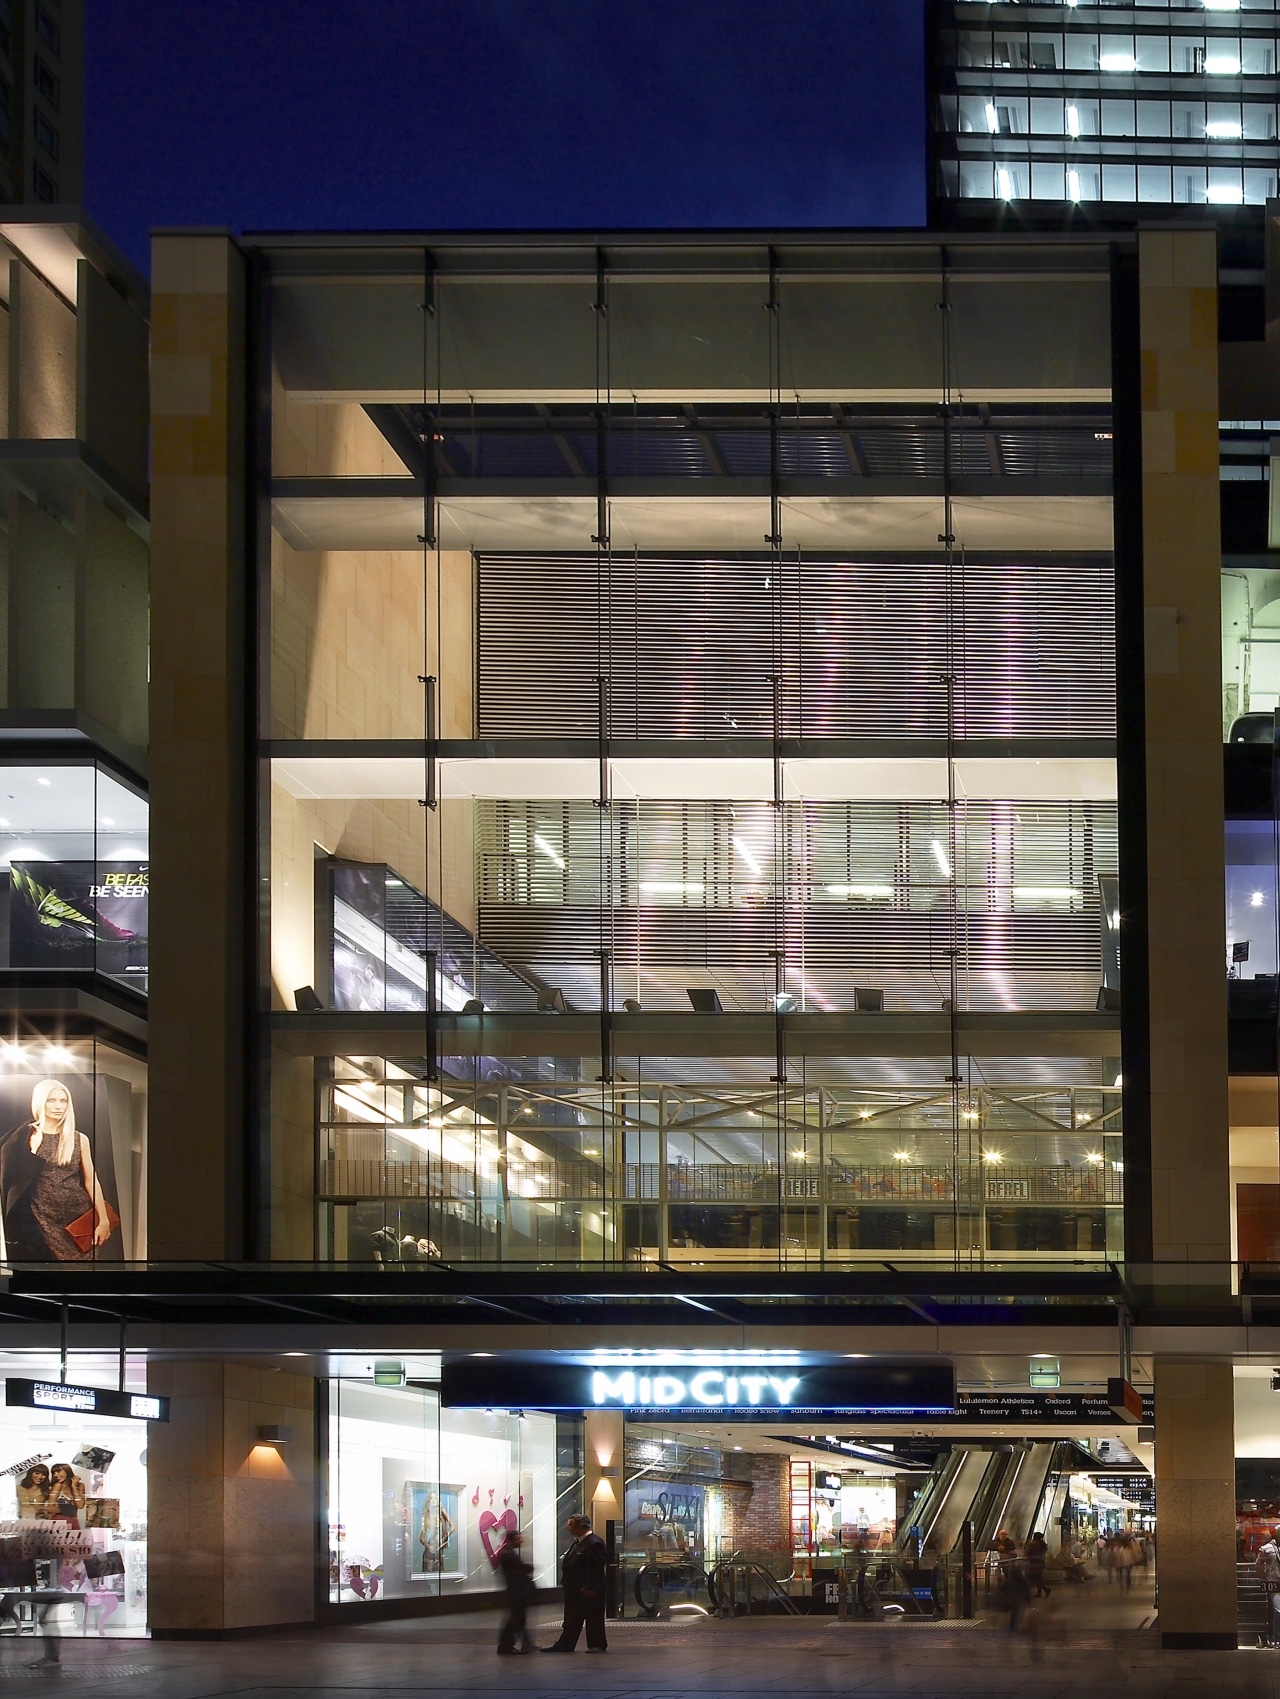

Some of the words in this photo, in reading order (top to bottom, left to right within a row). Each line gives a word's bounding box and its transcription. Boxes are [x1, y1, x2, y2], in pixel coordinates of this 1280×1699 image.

[102, 873, 125, 886] BE
[88, 885, 112, 898] BE
[34, 1383, 95, 1396] PERFORMANCE
[35, 1390, 74, 1401] SPORT
[959, 1397, 999, 1405] Lululemon
[1000, 1397, 1035, 1405] Athletica
[2, 1520, 67, 1534] double
[23, 1546, 33, 1556] 2
[68, 1546, 92, 1556] $10
